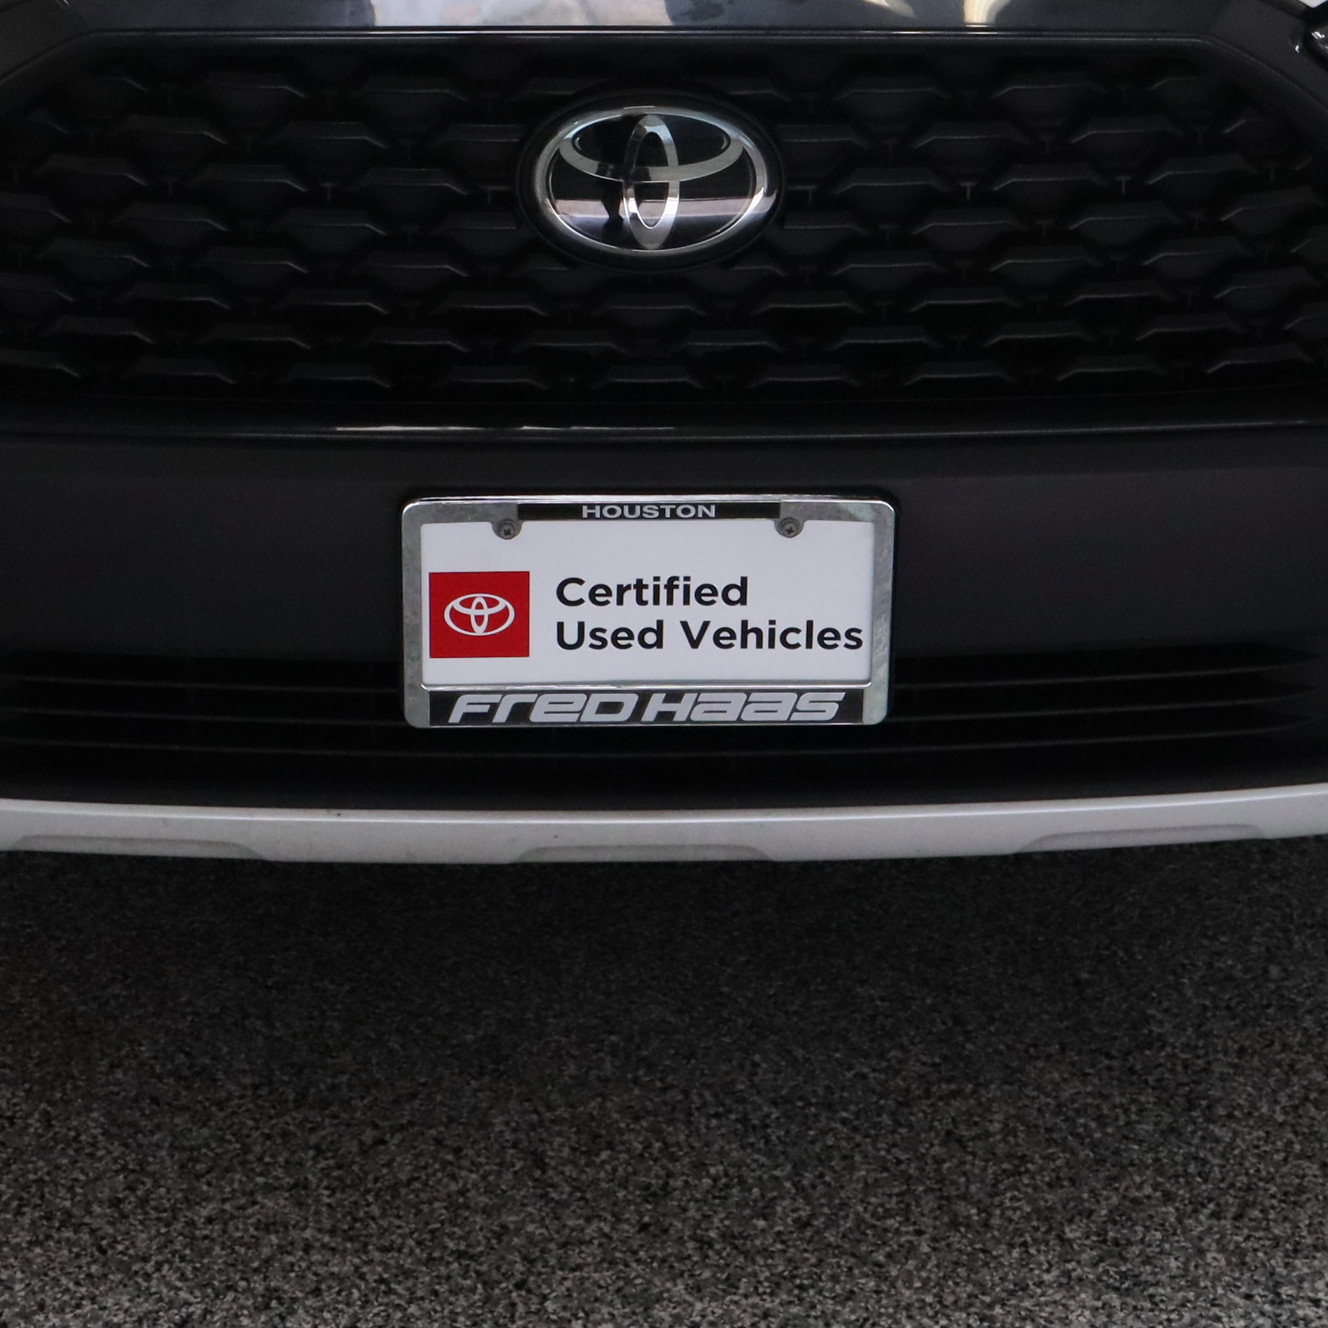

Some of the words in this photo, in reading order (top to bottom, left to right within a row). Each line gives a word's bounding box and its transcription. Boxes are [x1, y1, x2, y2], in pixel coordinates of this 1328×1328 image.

[581, 504, 716, 519] HOUSTON
[555, 576, 749, 606] Certified
[555, 619, 665, 650] Used
[679, 619, 864, 651] Vehicles
